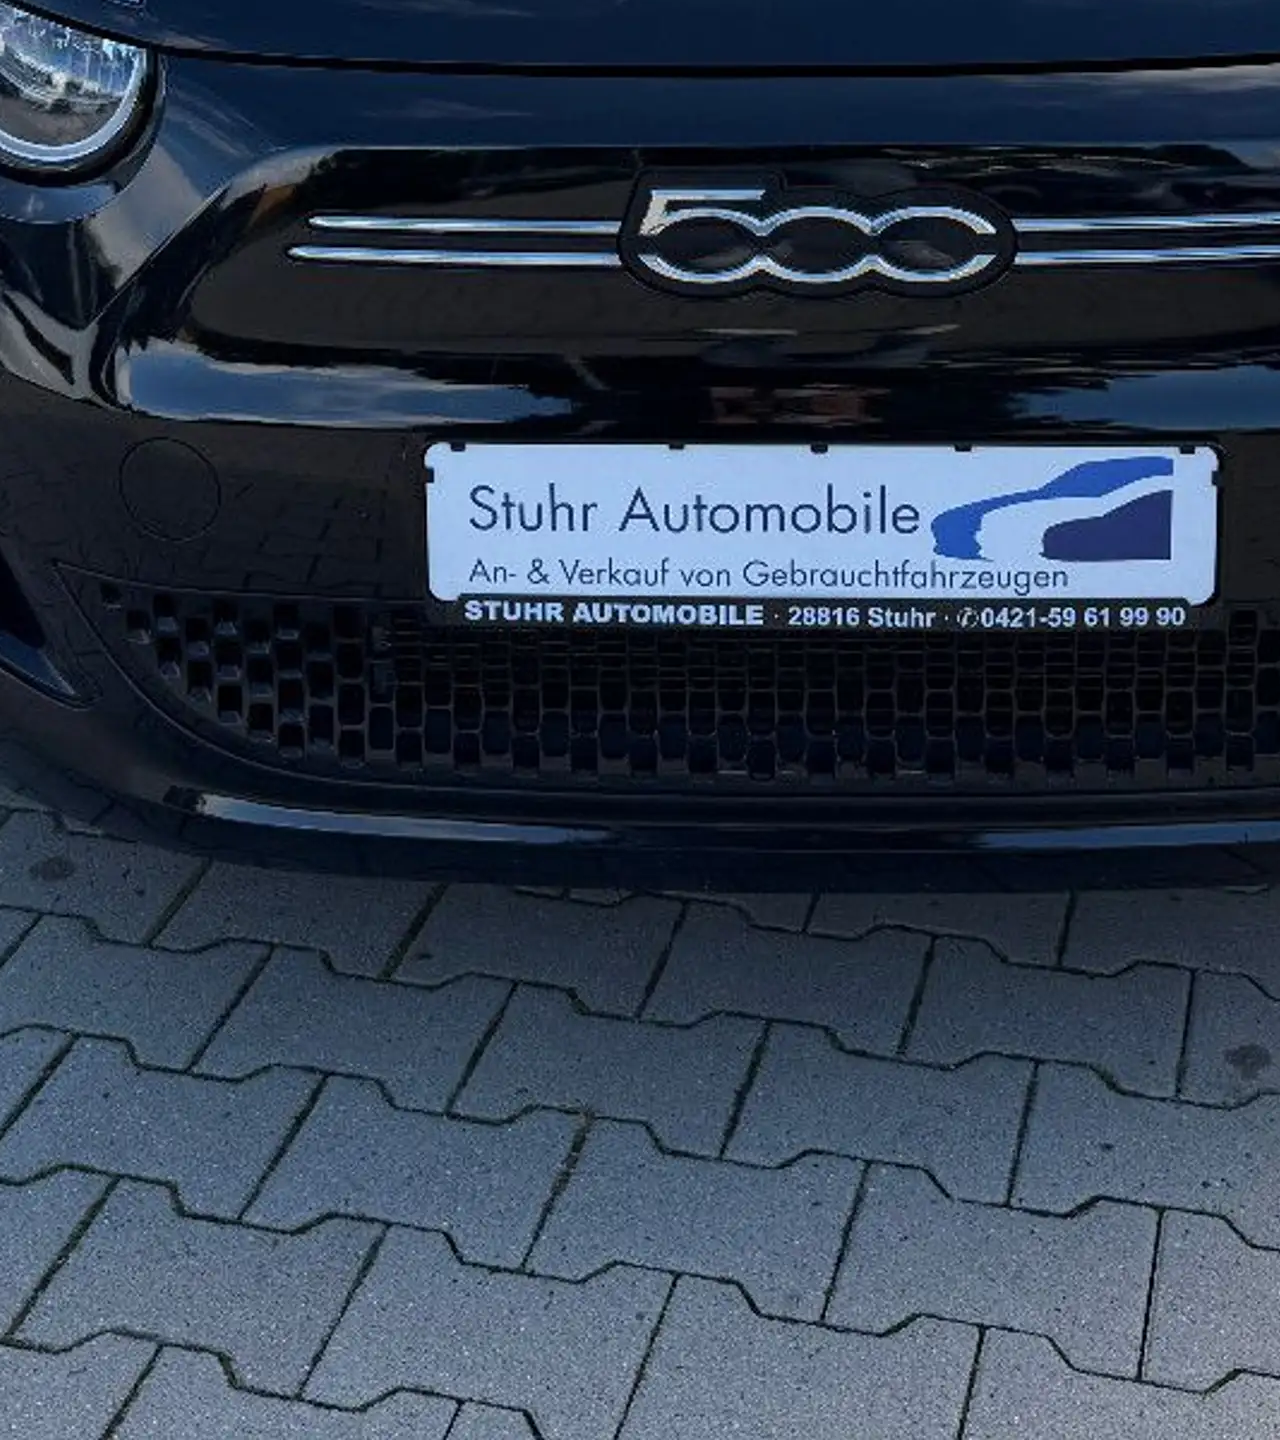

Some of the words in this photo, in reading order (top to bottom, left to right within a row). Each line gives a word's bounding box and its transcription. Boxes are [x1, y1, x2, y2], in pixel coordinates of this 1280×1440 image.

[638, 189, 997, 283] 500
[468, 483, 598, 533] Stuhr
[619, 483, 920, 534] Automobile
[468, 558, 517, 584] An-
[526, 558, 551, 585] &
[559, 557, 670, 587] Verkauf
[679, 565, 732, 588] von
[743, 558, 1069, 596] Gebrauchtfahrzeugen
[464, 599, 565, 623] STUHR
[572, 601, 765, 626] AUTOMOBILE
[787, 605, 860, 626] 28816
[867, 605, 936, 628] Stuhr
[1084, 605, 1110, 627] 61
[1119, 605, 1150, 627] 99
[1155, 605, 1187, 627] 90
